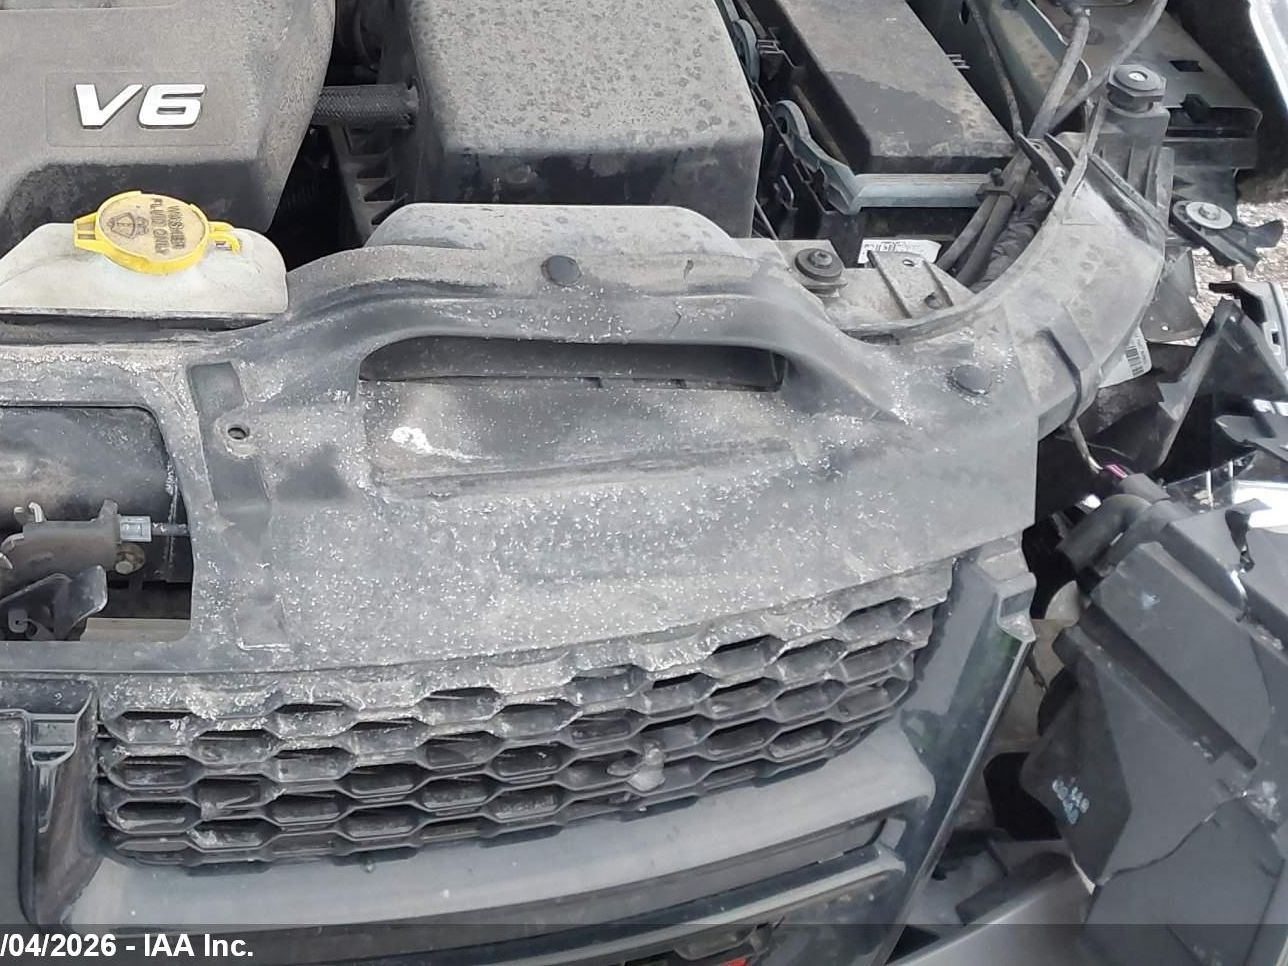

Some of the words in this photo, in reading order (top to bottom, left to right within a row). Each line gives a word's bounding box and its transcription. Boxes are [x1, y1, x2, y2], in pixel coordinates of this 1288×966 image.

[74, 83, 207, 129] V6
[150, 198, 167, 228] FLUID
[168, 205, 186, 250] WASHER
[152, 228, 170, 255] ONLY
